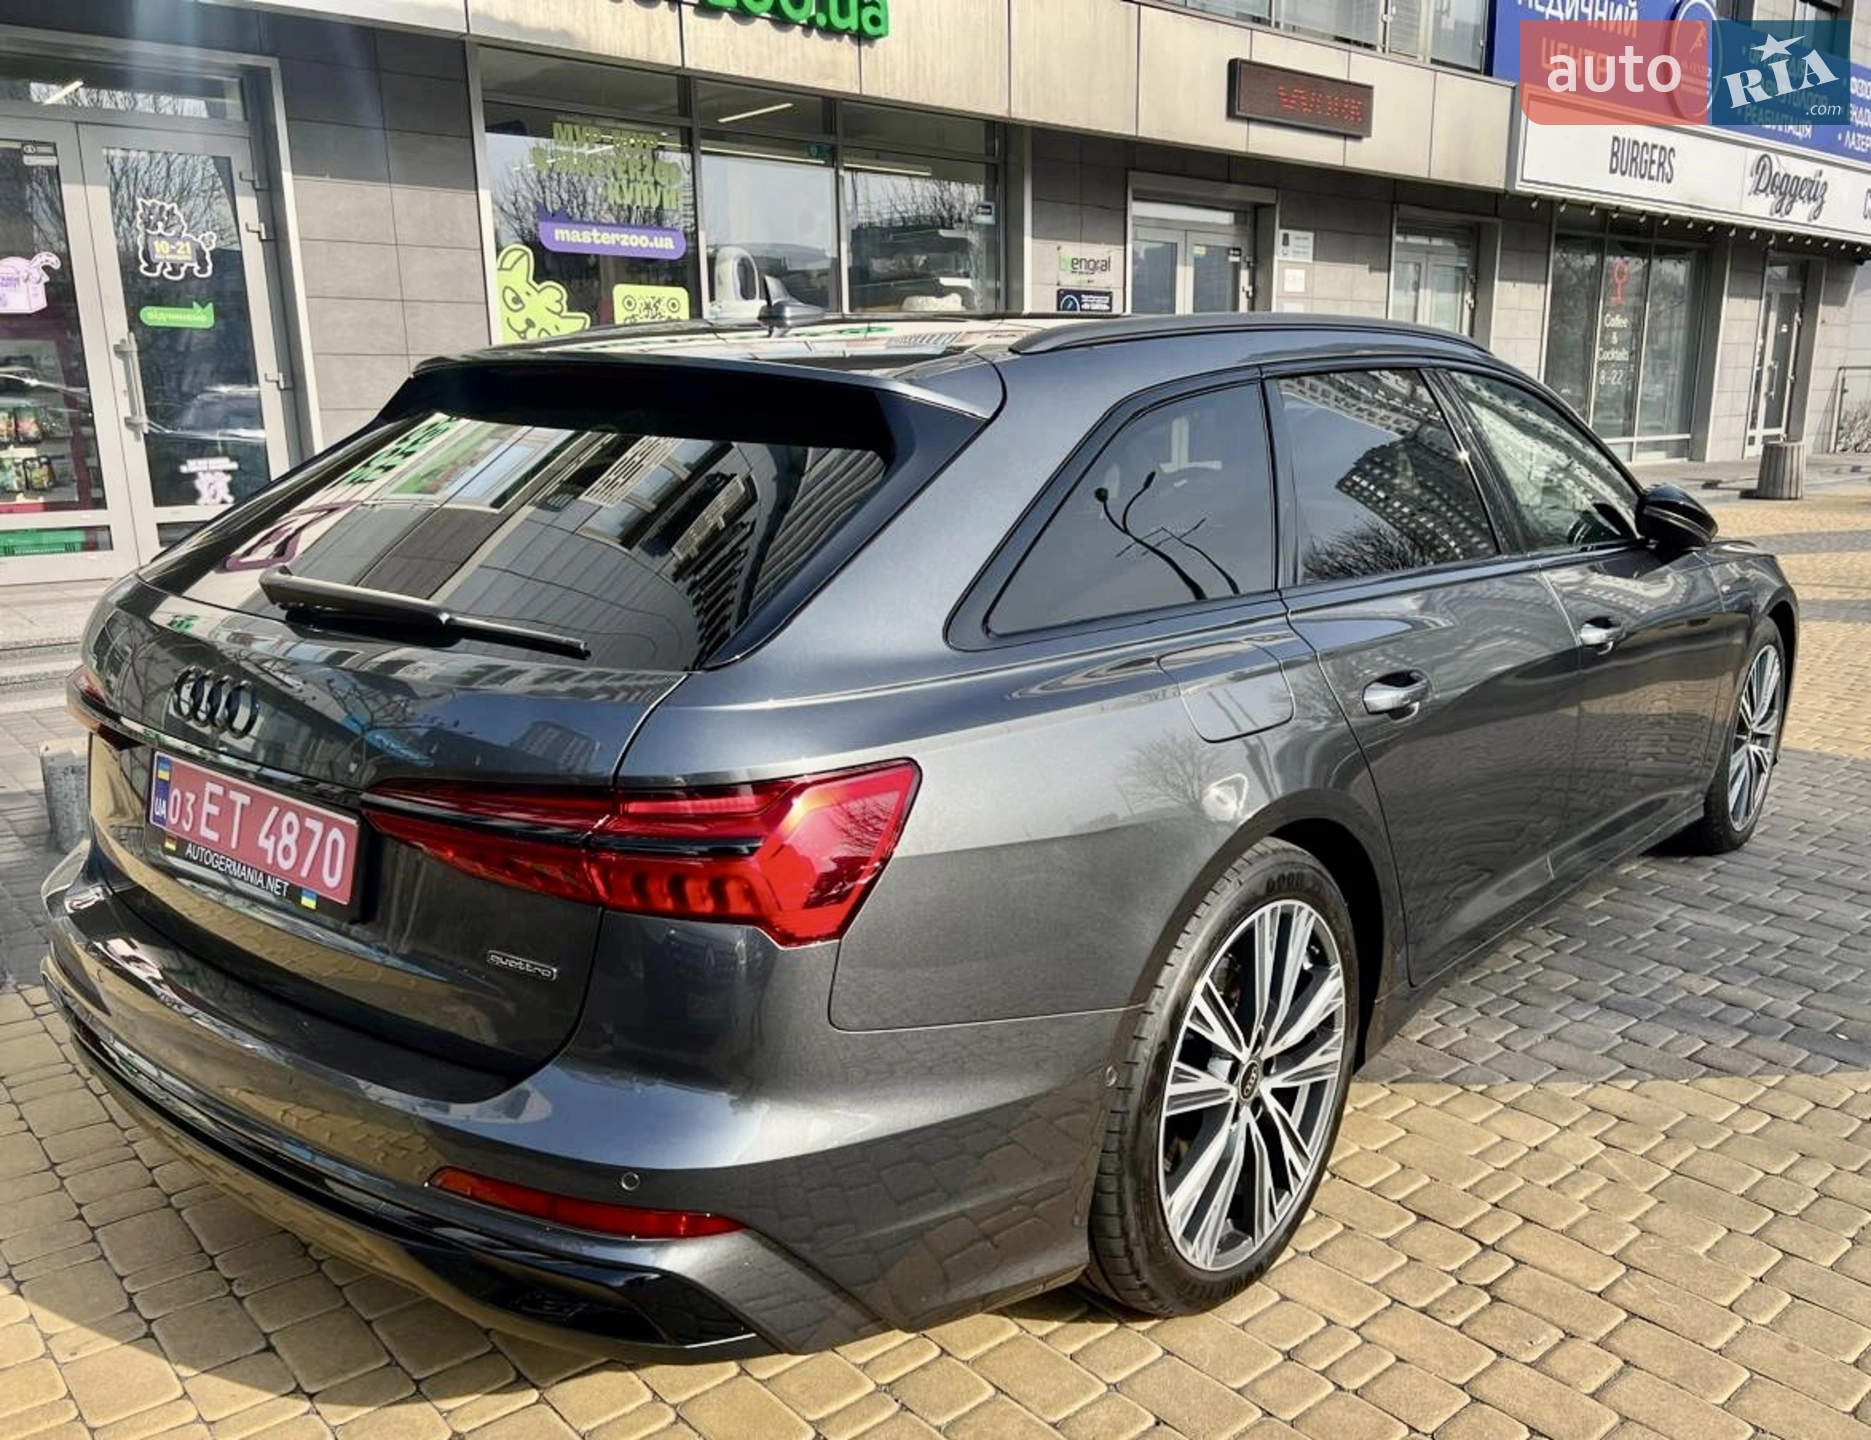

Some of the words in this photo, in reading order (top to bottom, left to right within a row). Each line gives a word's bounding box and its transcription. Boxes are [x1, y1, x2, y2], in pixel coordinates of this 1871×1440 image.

[1517, 0, 1639, 39] ДИЧНИЙ
[1609, 135, 1676, 184] BURGERS
[554, 228, 676, 250] masterzoo.ua
[154, 798, 167, 819] UA
[169, 788, 196, 832] 03
[200, 782, 250, 849] ET
[258, 806, 346, 889] 4870
[185, 843, 290, 897] AUTOGERMANIA.NET
[490, 954, 551, 978] quattro
